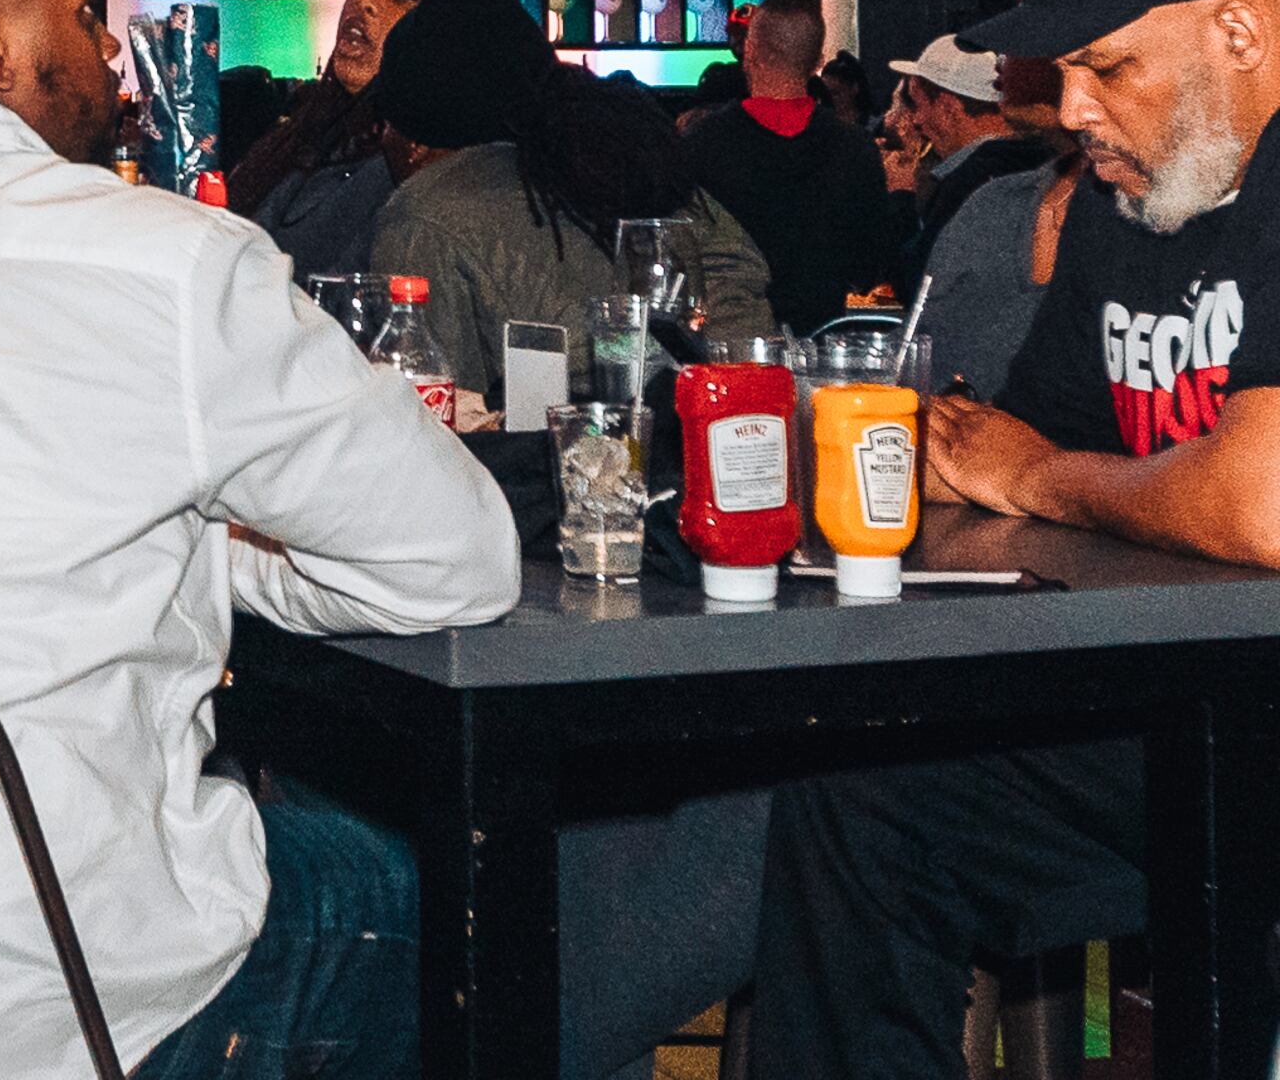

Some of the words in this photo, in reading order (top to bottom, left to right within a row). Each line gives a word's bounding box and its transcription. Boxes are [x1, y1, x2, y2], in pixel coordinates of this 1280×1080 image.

[734, 423, 768, 439] HEINZ
[876, 436, 904, 447] HEINZ
[870, 464, 906, 475] MUSTARD
